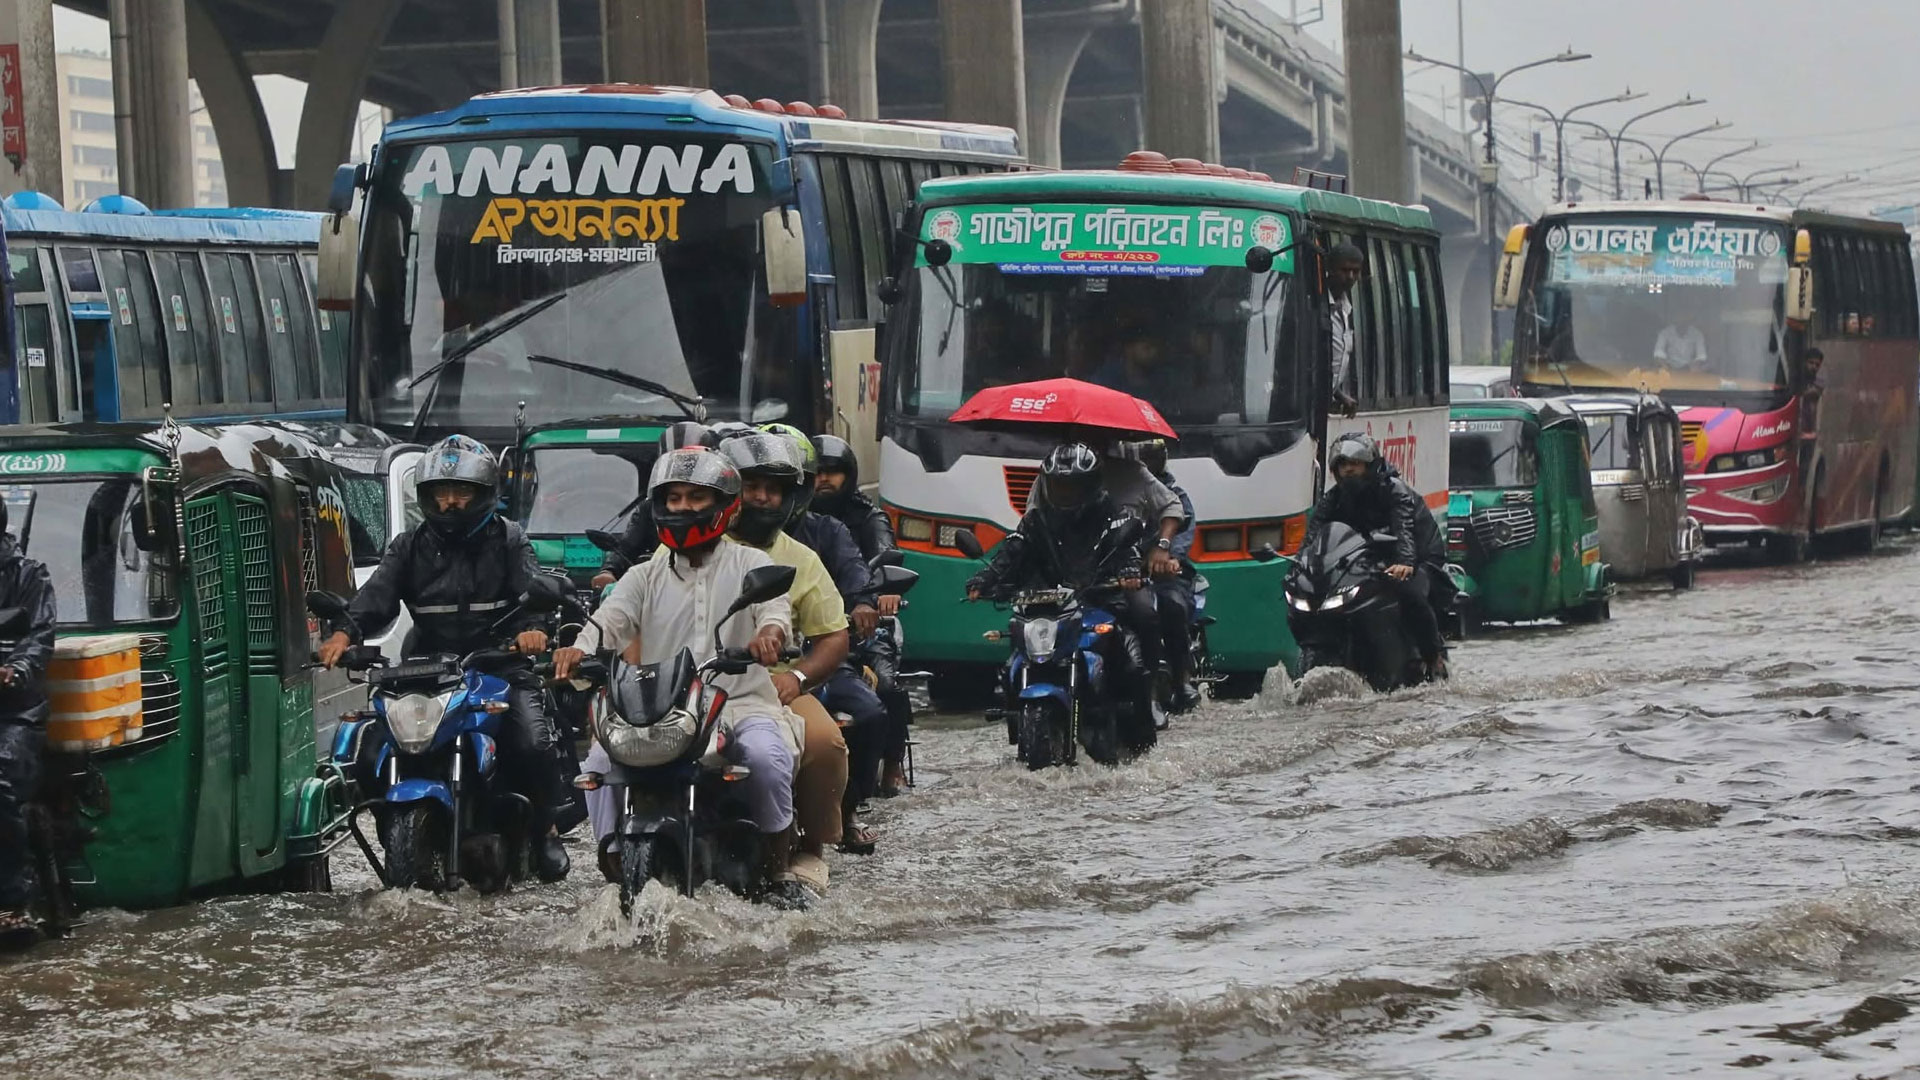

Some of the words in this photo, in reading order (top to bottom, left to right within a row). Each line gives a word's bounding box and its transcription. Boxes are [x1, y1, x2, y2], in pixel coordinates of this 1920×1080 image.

[402, 143, 755, 197] ANANNA
[525, 197, 685, 242] অনন্যা
[969, 208, 1075, 251] গাজীপুর
[1084, 208, 1190, 250] পরিবহন
[1568, 225, 1658, 253] আলম
[1667, 221, 1760, 256] এশিয়া
